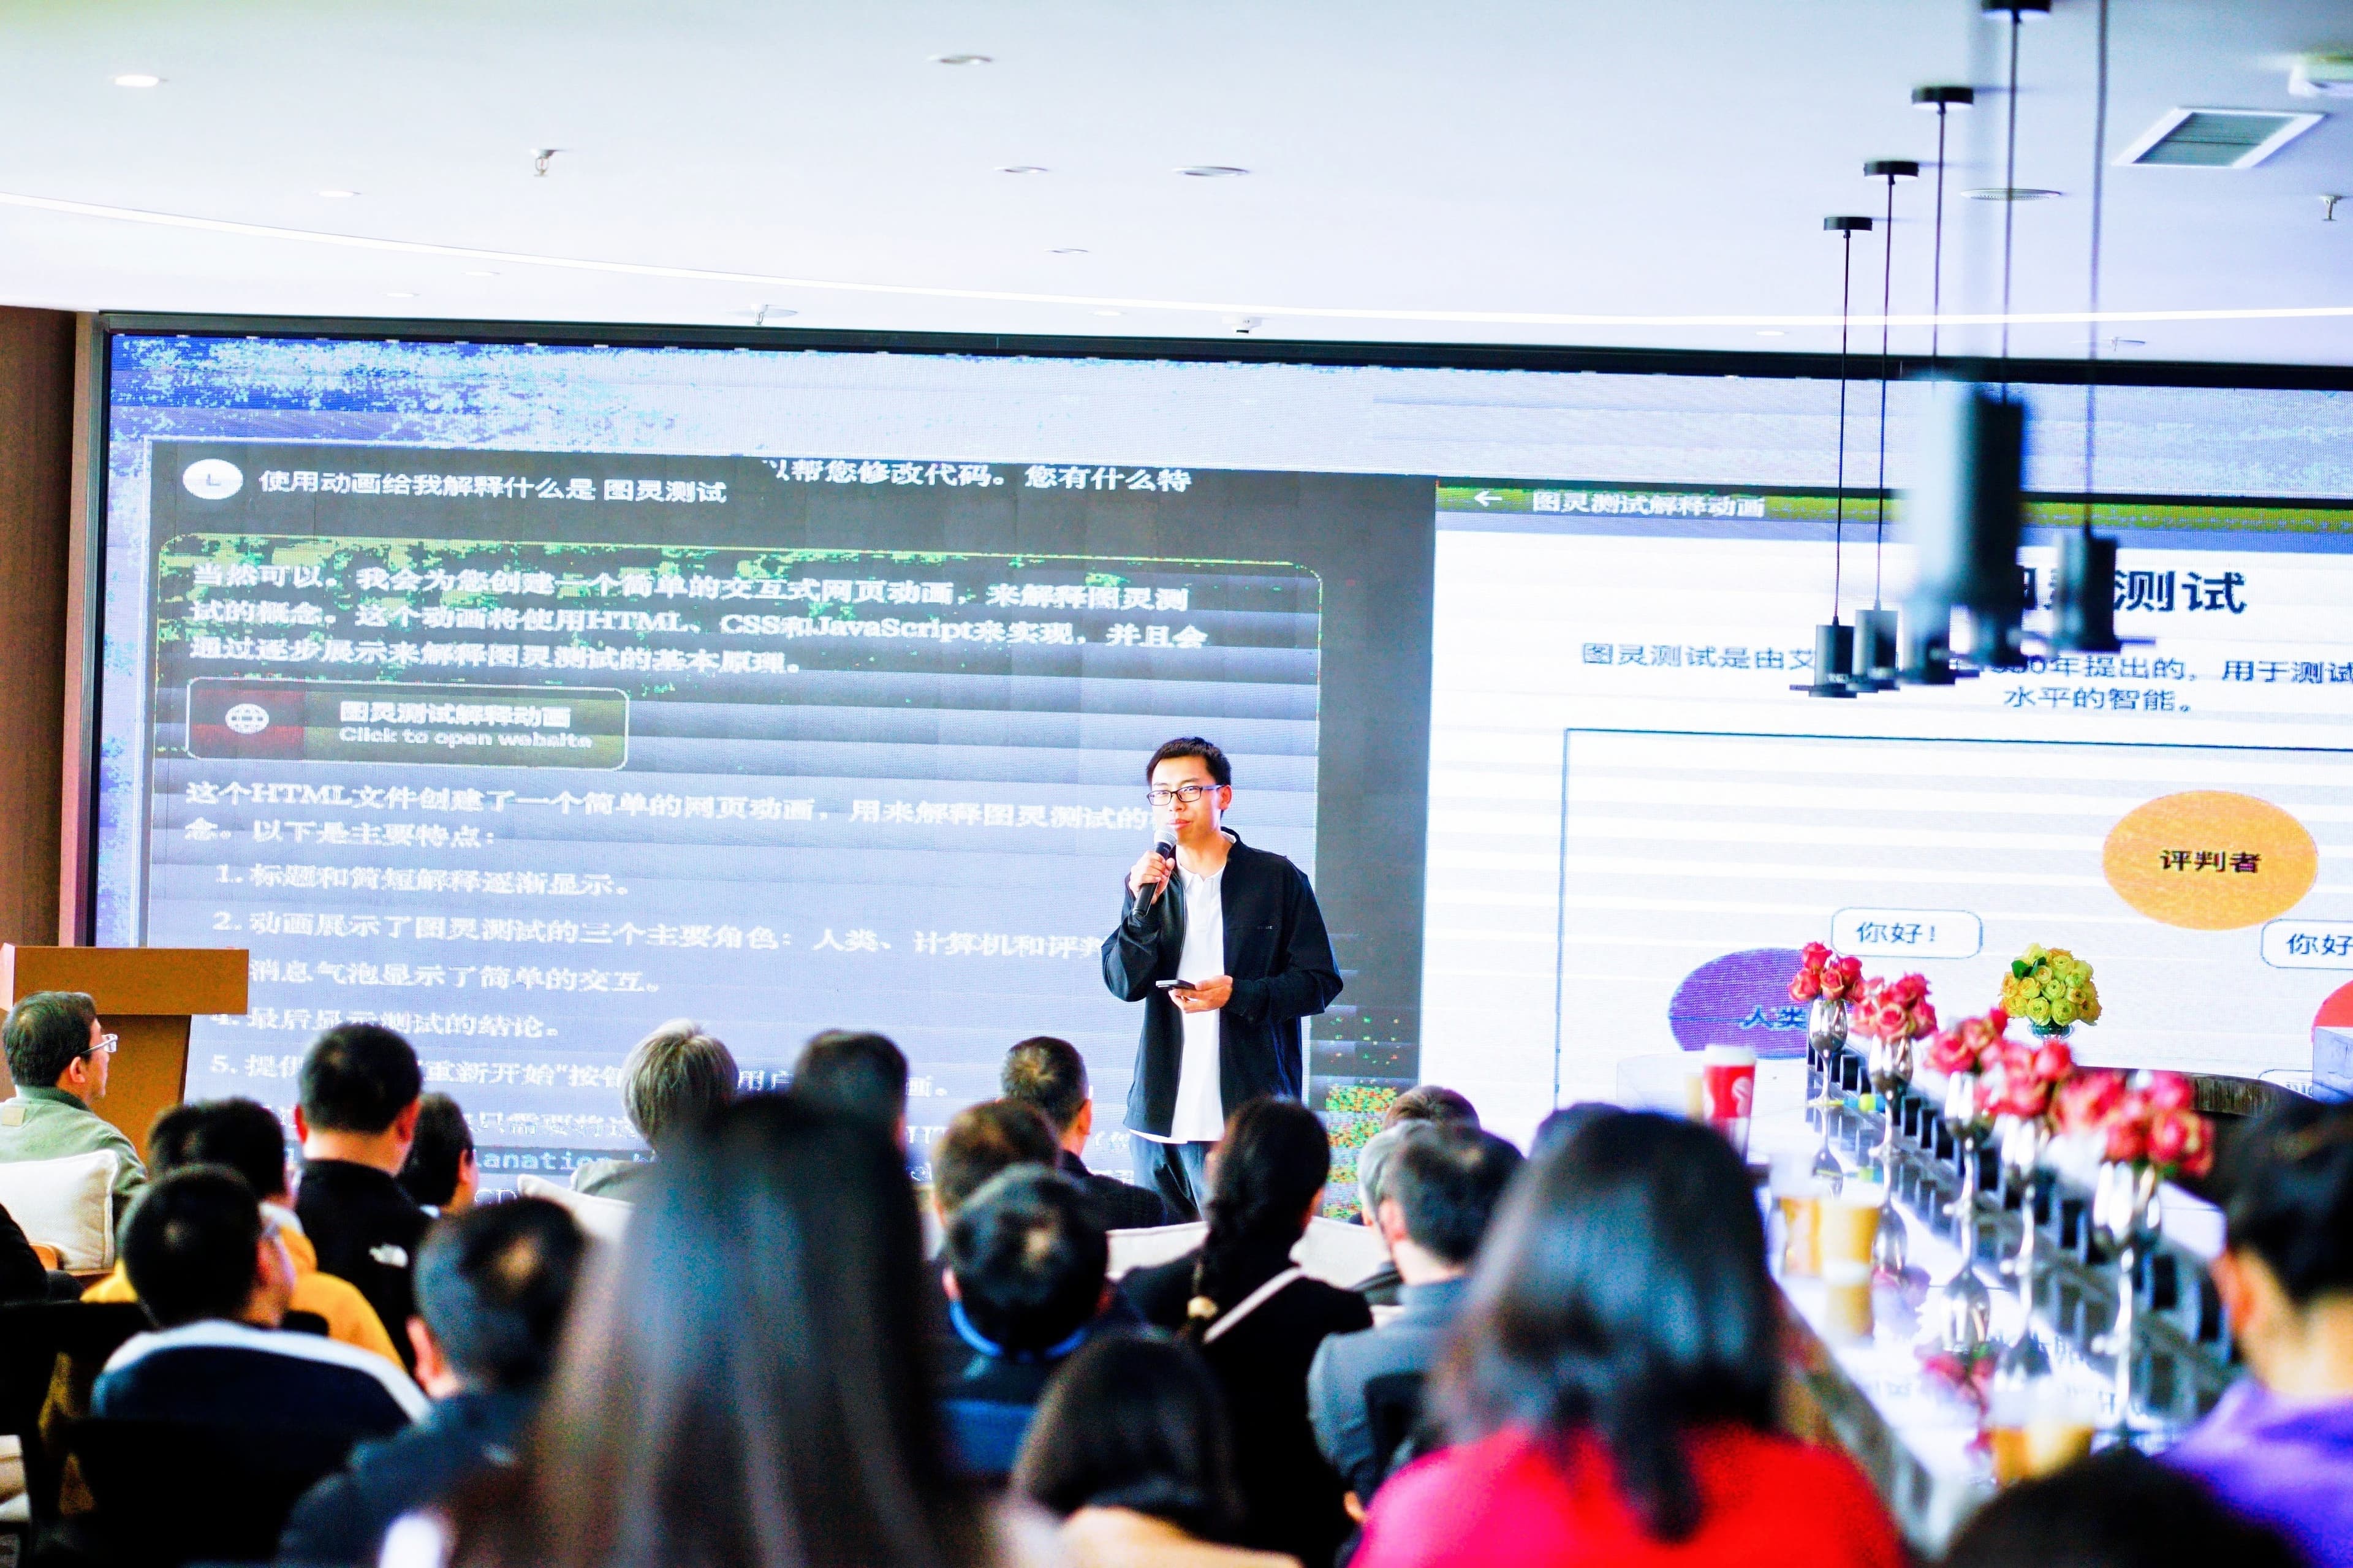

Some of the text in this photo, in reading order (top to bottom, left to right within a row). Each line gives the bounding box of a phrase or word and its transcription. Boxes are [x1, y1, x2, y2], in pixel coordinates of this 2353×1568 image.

[1532, 491, 1765, 518] 图灵测试解释动画
[2004, 687, 2191, 711] 水平的智能。
[339, 702, 571, 729] 图灵测试解释动画
[339, 726, 593, 749] Click to open website
[186, 782, 1156, 830] 这个HTML文件创建了一个简单的网页动画，用来解释图灵测试的
[2159, 849, 2261, 874] 评判者
